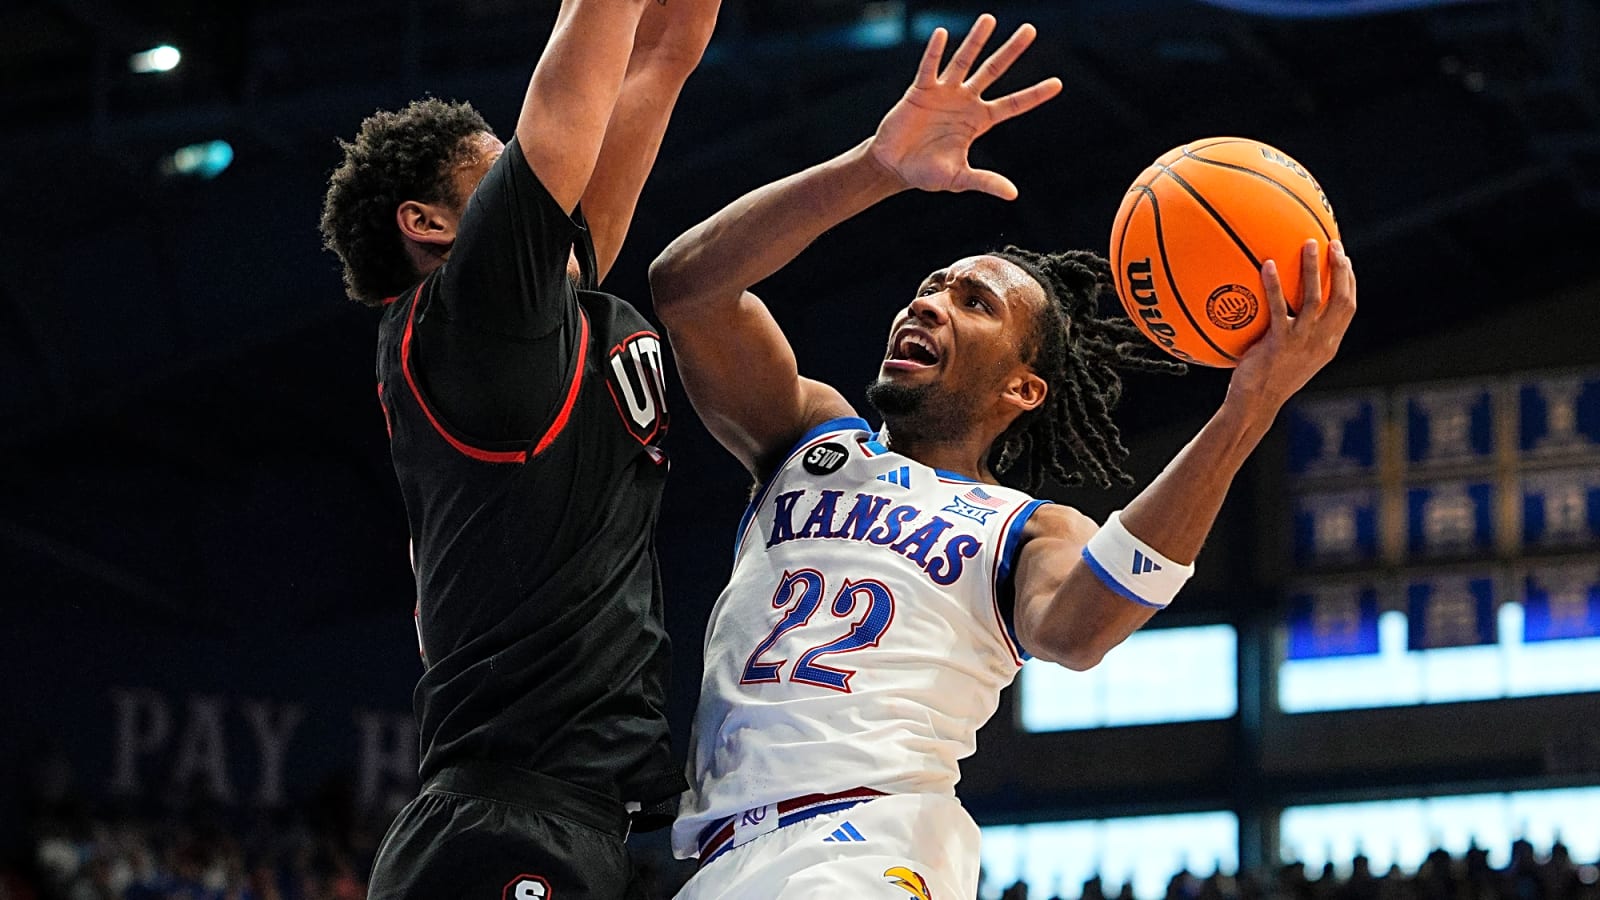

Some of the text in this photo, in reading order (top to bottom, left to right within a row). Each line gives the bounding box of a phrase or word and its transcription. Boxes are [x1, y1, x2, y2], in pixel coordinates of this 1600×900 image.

[1127, 256, 1195, 362] Wilso
[807, 446, 845, 469] SW
[765, 489, 983, 586] KANSAS
[739, 567, 896, 694] 22
[110, 688, 305, 807] PAY
